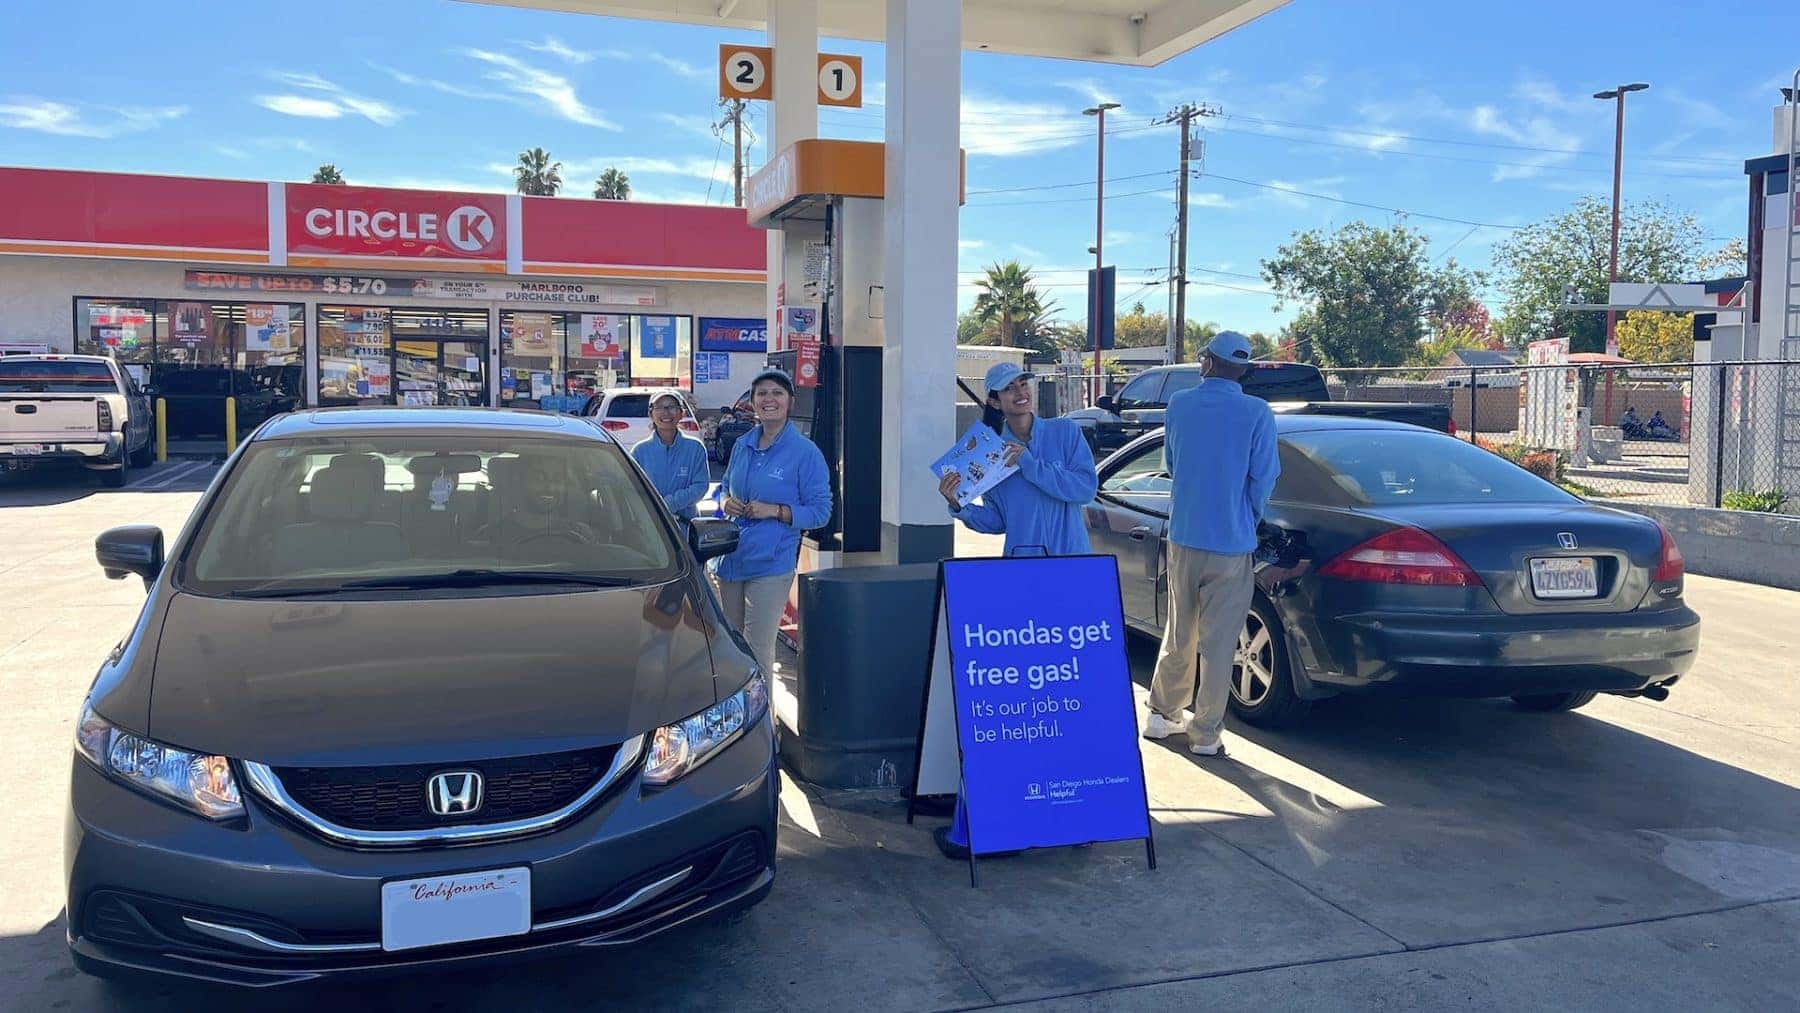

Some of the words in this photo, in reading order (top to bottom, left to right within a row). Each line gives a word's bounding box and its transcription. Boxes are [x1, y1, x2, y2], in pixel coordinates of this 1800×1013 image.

[736, 60, 754, 84] 2
[832, 68, 843, 91] 1
[305, 207, 437, 240] CIRCLE
[459, 213, 490, 249] K
[322, 277, 387, 296] $5.70
[506, 291, 565, 302] PURCHASE
[567, 294, 600, 303] CLUB!
[521, 283, 583, 293] MARLBORO
[964, 620, 1063, 647] Hondas
[1068, 620, 1112, 649] get
[966, 661, 1019, 686] free
[1027, 656, 1080, 689] gas!
[971, 700, 994, 717] It's
[999, 701, 1027, 715] our
[1031, 695, 1059, 718] job
[1063, 697, 1081, 711] to
[973, 724, 997, 742] be
[1001, 719, 1063, 743] helpful.
[1050, 789, 1075, 798] Helpful
[1062, 780, 1082, 789] Diego
[1083, 778, 1104, 786] Honda
[1105, 776, 1129, 785] Dealers
[414, 877, 503, 901] California
